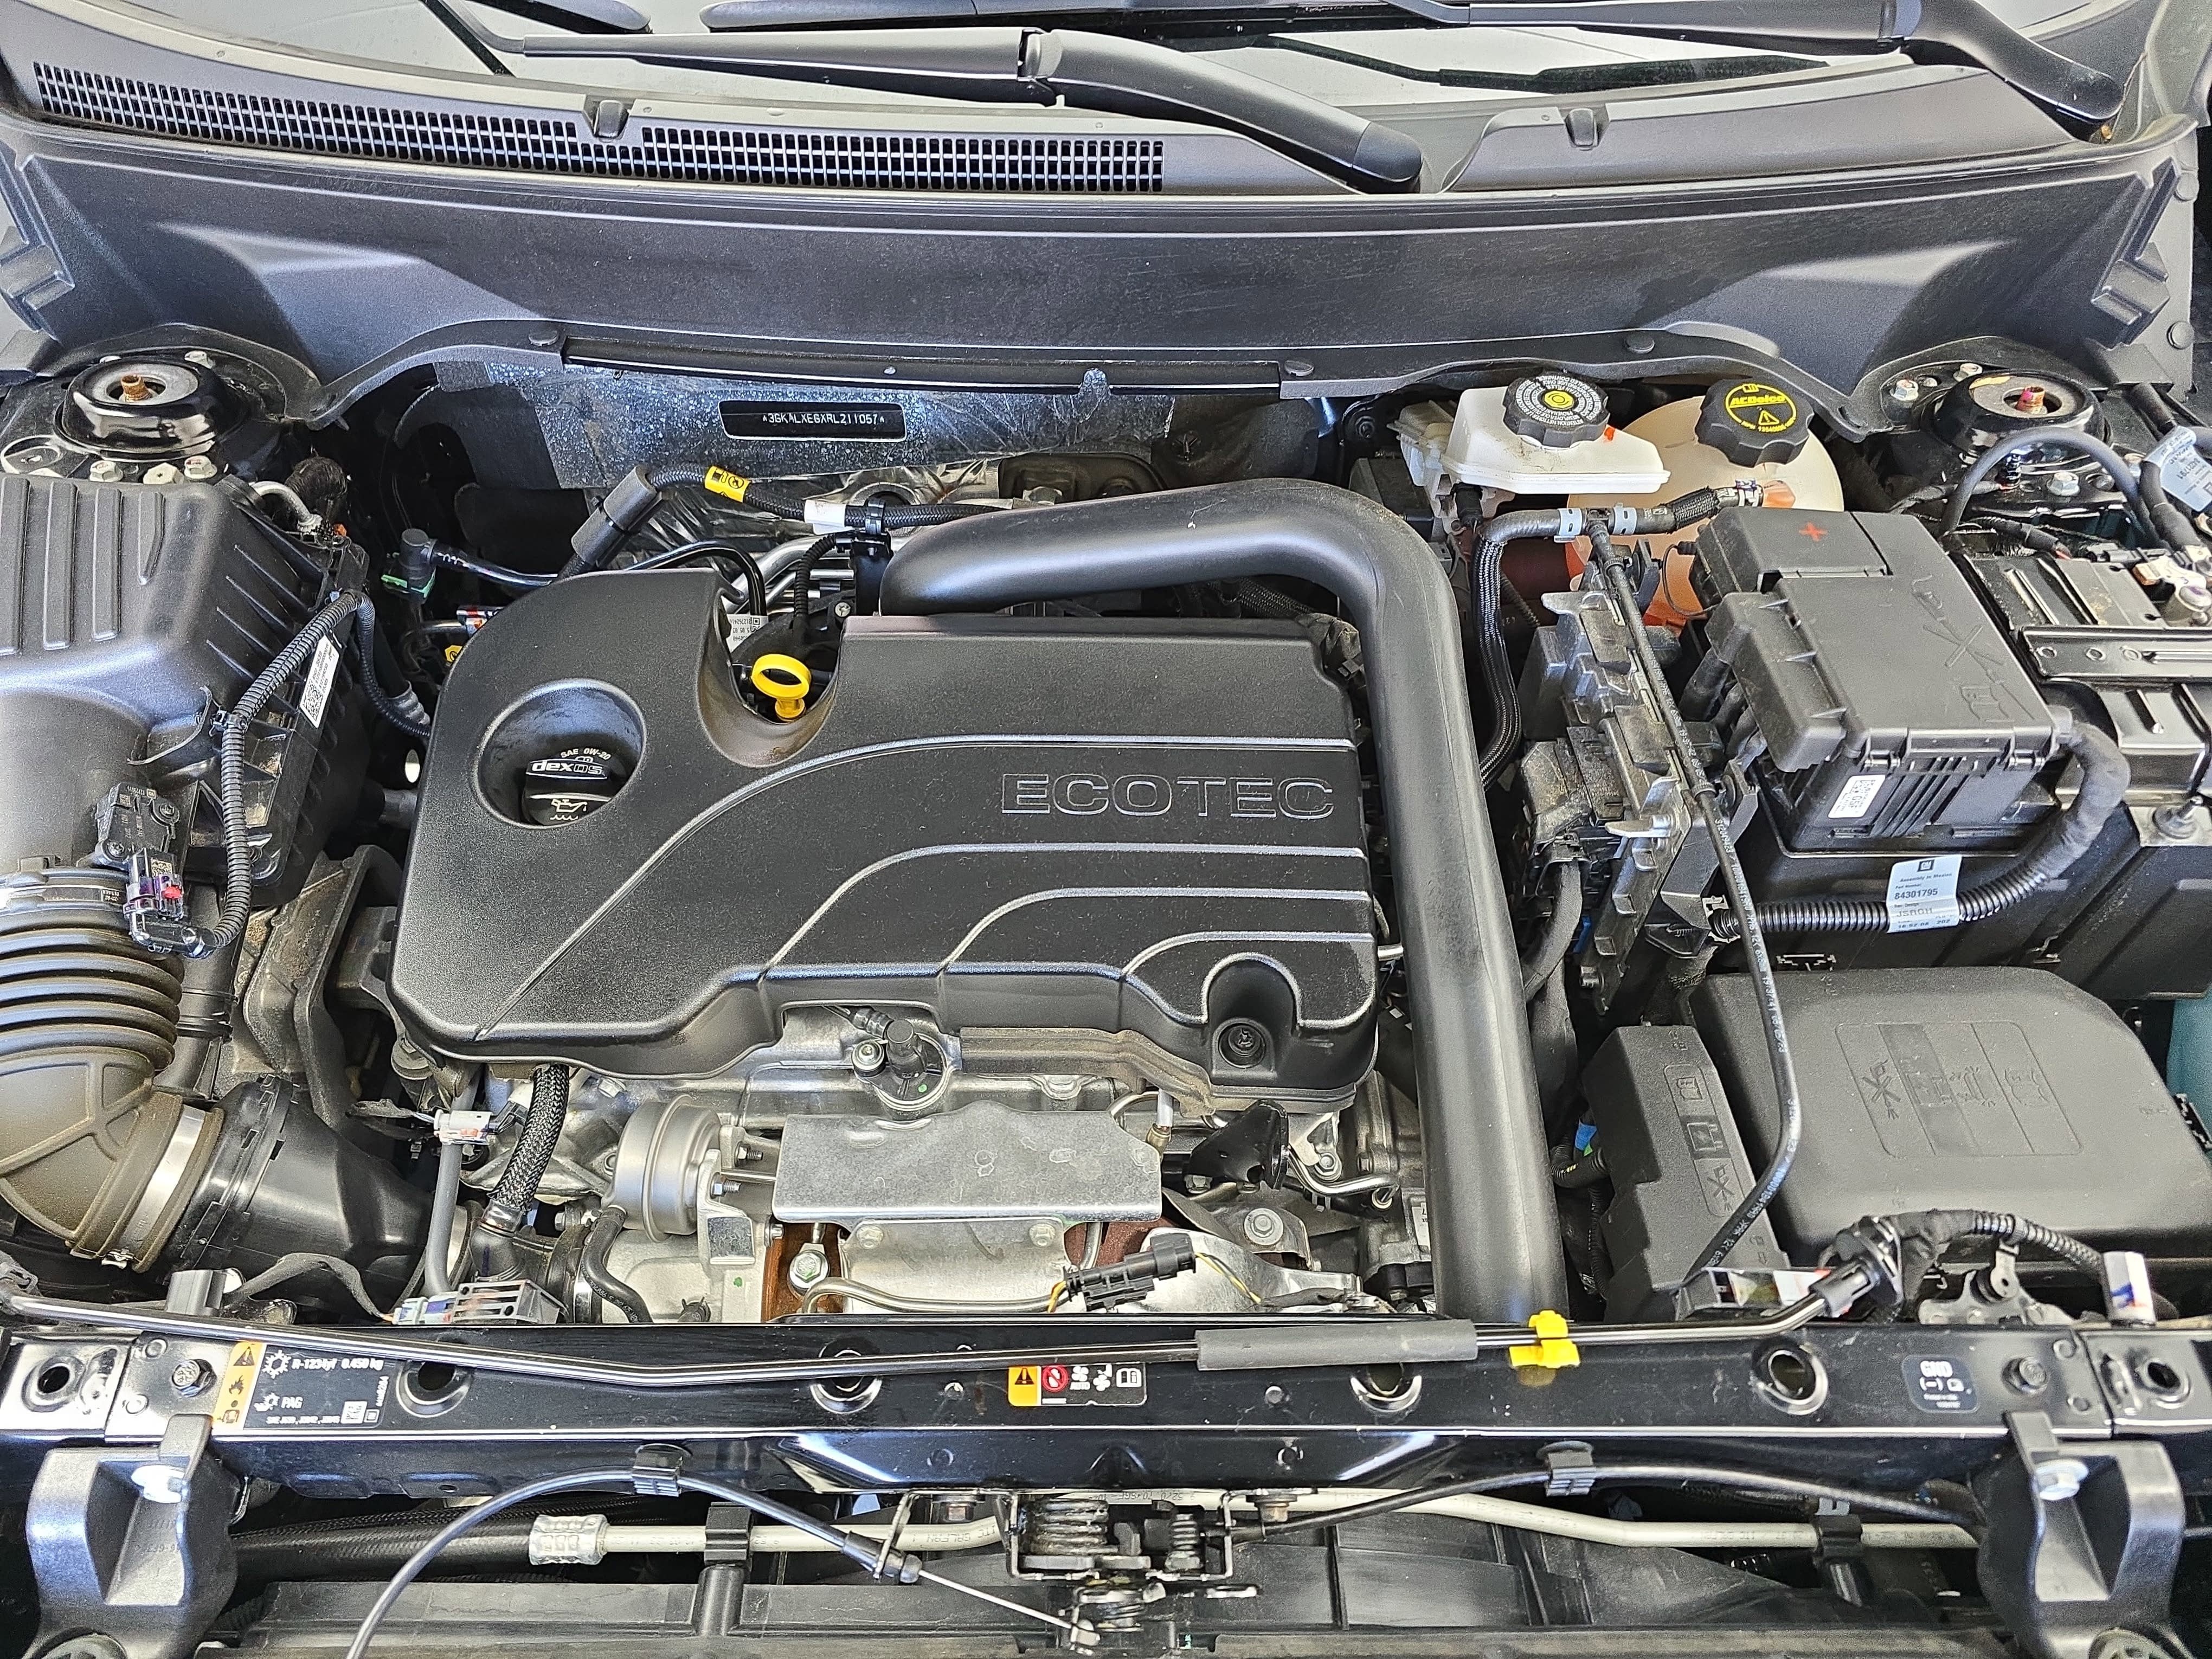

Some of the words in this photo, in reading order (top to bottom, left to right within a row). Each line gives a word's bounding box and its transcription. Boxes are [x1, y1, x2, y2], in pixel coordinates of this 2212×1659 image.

[1730, 395, 1785, 406] ACDelco
[561, 749, 579, 758] SAE
[583, 748, 611, 760] 0W-20
[531, 761, 602, 775] dexos
[1002, 774, 1334, 819] ECOTEC
[1894, 888, 1938, 900] 84301795
[281, 1397, 303, 1409] PAG
